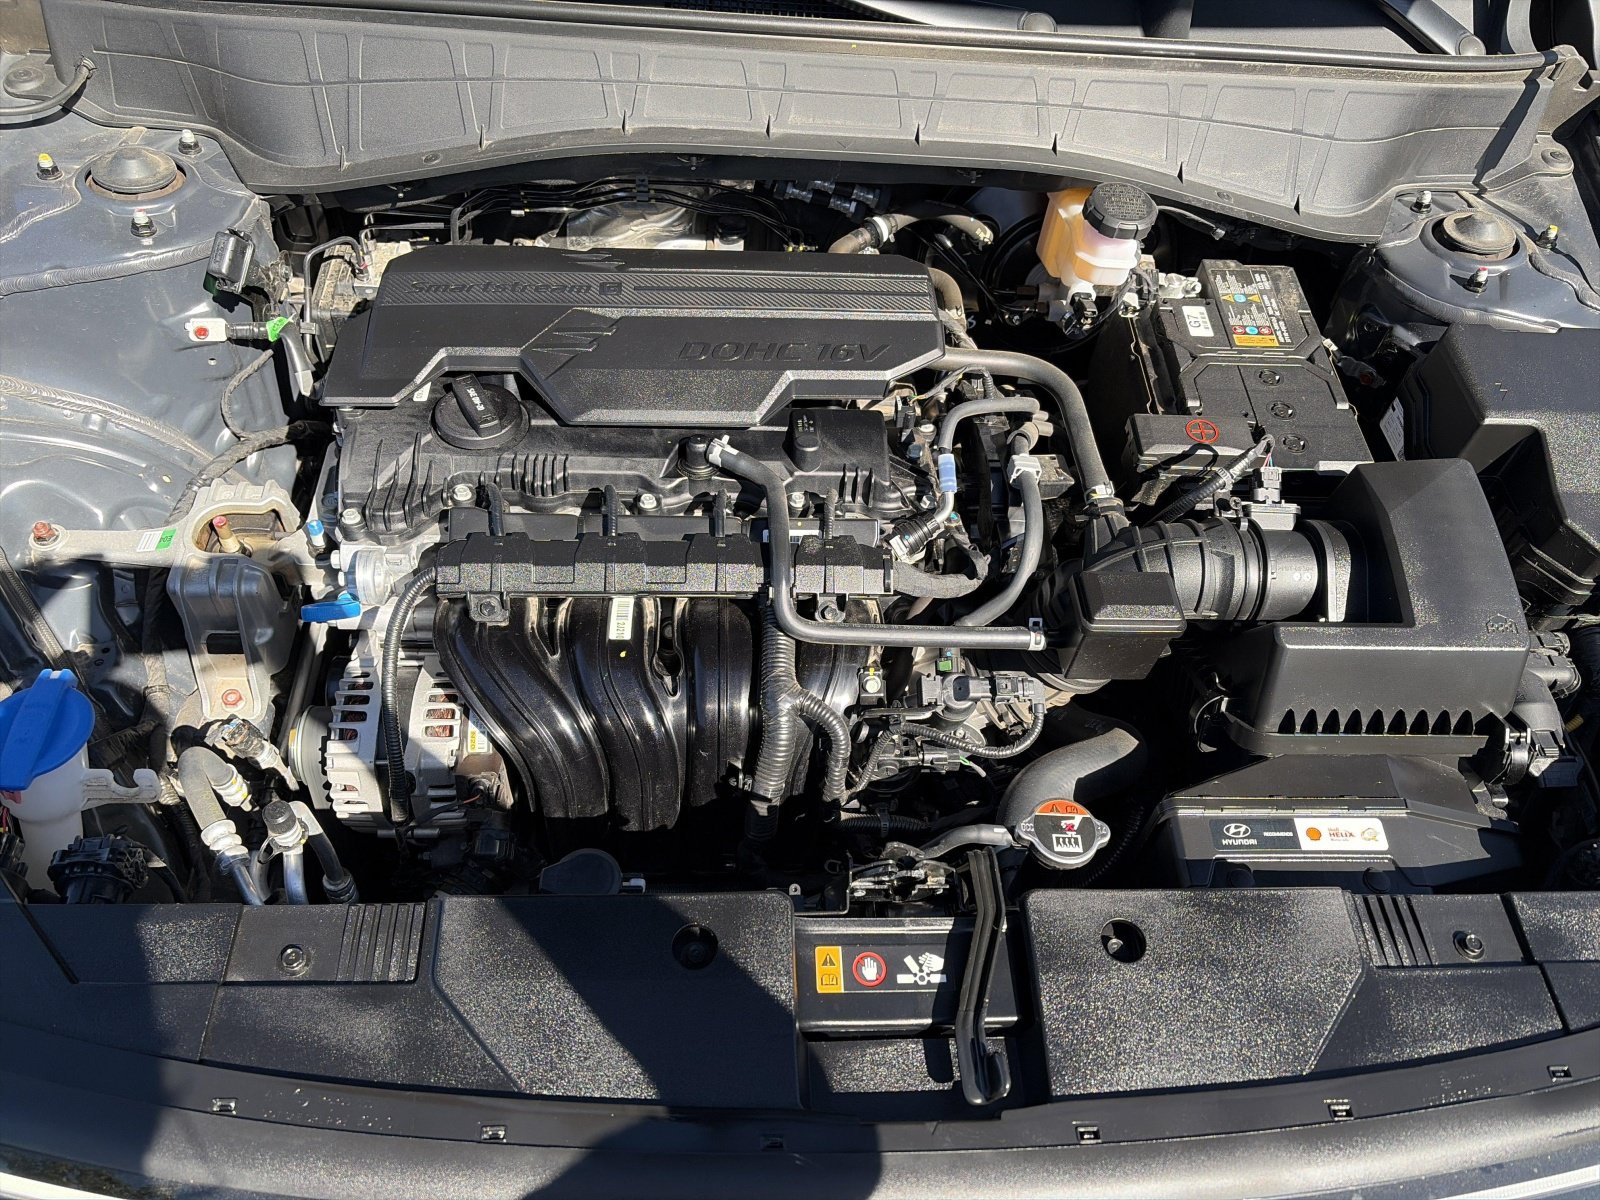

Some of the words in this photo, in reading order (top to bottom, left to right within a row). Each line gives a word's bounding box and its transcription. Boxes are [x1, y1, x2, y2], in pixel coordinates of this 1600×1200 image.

[404, 281, 592, 294] Smartstream
[1187, 314, 1201, 327] G7
[677, 341, 808, 362] DOHC
[817, 342, 892, 363] 16V
[1222, 838, 1258, 846] HYUNDAI
